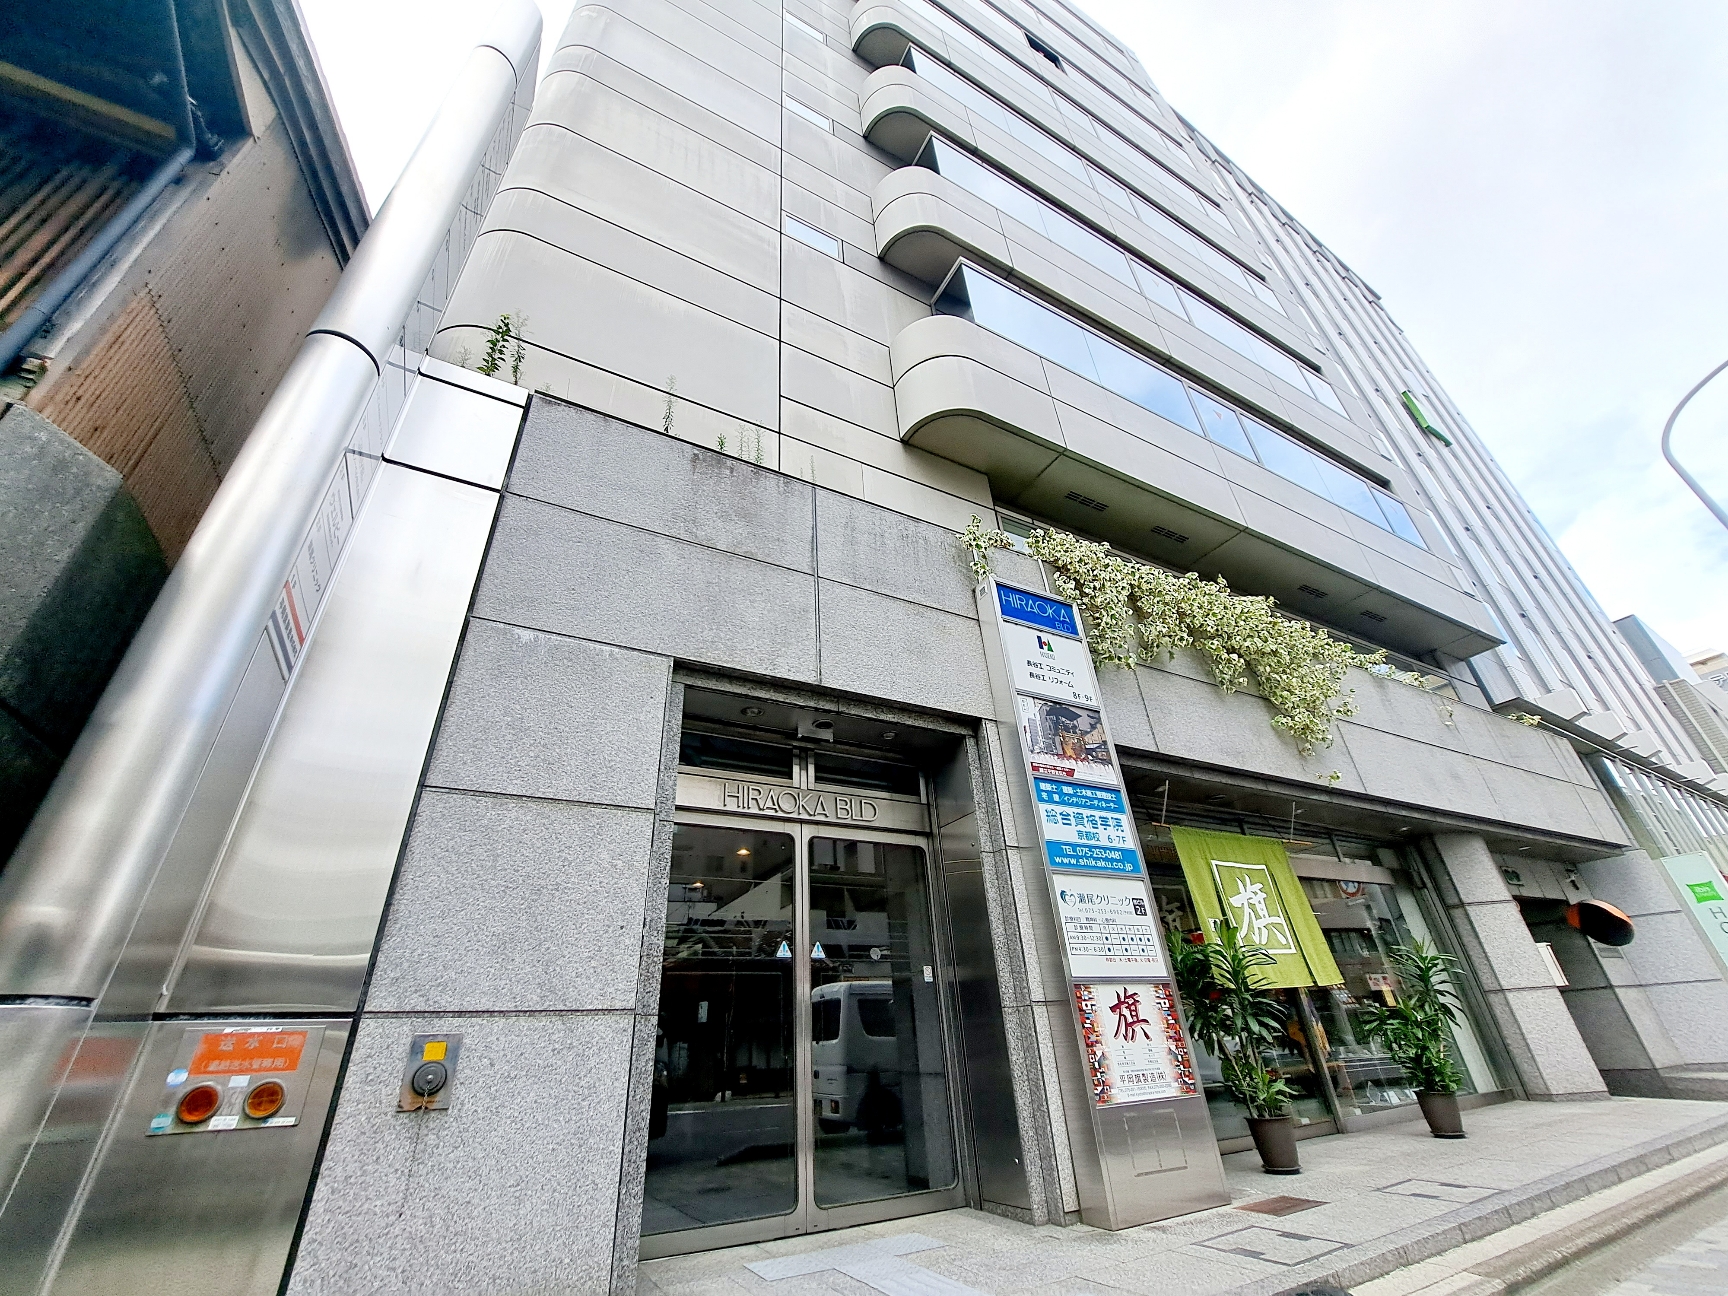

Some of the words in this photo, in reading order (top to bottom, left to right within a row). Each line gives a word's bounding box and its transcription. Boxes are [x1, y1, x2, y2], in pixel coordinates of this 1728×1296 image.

[1000, 590, 1071, 624] HIRAOKA
[1055, 621, 1072, 633] BLD
[723, 782, 830, 818] HIRAOKA
[835, 796, 879, 822] BLD
[1045, 807, 1125, 833] 総合資格学院
[1076, 829, 1102, 842] 京都校
[1054, 856, 1134, 872] www.shikaku.co.jp
[1076, 893, 1131, 906] 瀬尾クリニック
[1228, 873, 1288, 946] 旗
[1135, 906, 1146, 915] 2F
[1108, 985, 1153, 1044] 旗
